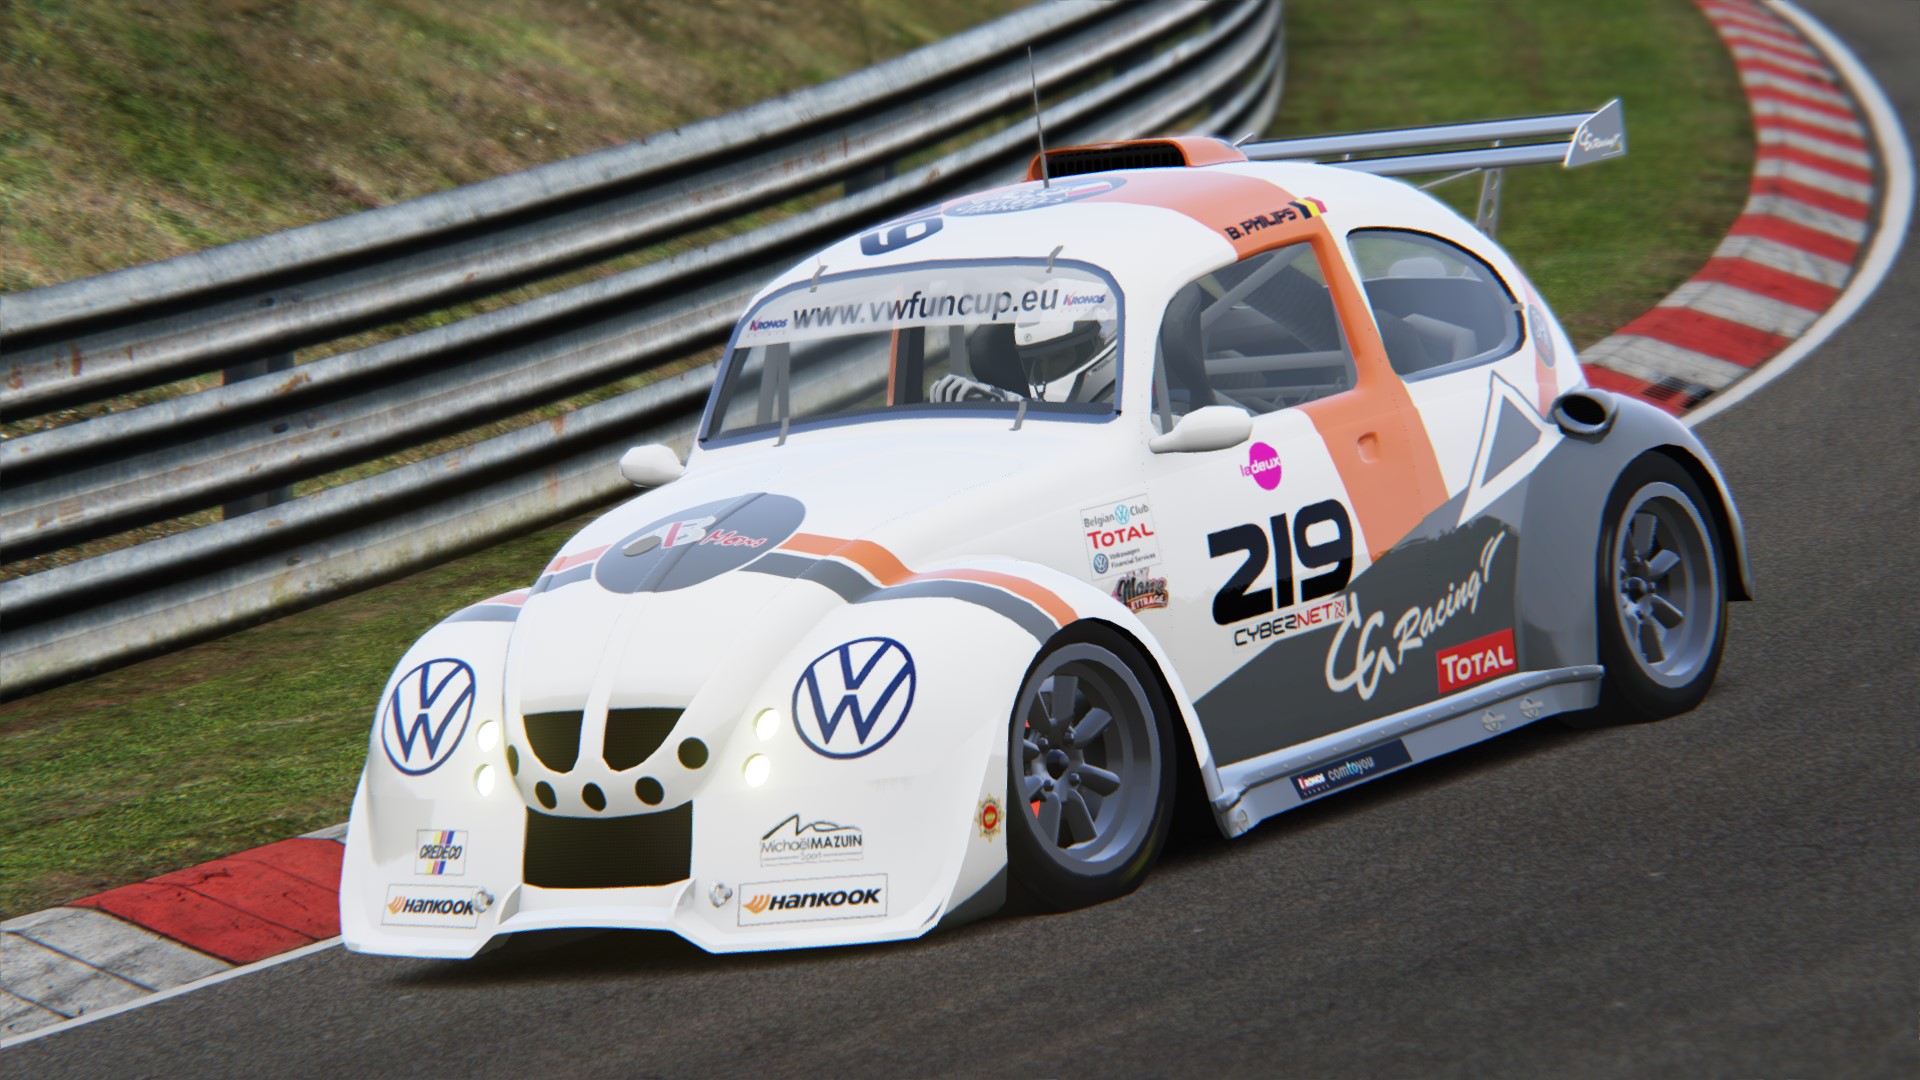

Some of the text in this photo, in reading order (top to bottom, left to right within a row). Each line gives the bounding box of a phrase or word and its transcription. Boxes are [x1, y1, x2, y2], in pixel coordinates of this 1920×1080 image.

[749, 287, 1106, 331] KRONOS www.vwfuncup.eu KRONOS
[1084, 512, 1115, 529] Belgian
[1130, 502, 1149, 516] Club
[1087, 523, 1154, 549] TOTAL
[1207, 498, 1354, 626] 219
[1392, 569, 1483, 665] Racing
[1440, 645, 1515, 685] TOTAL
[1328, 756, 1375, 782] comtoyou
[419, 844, 463, 860] CREDECO
